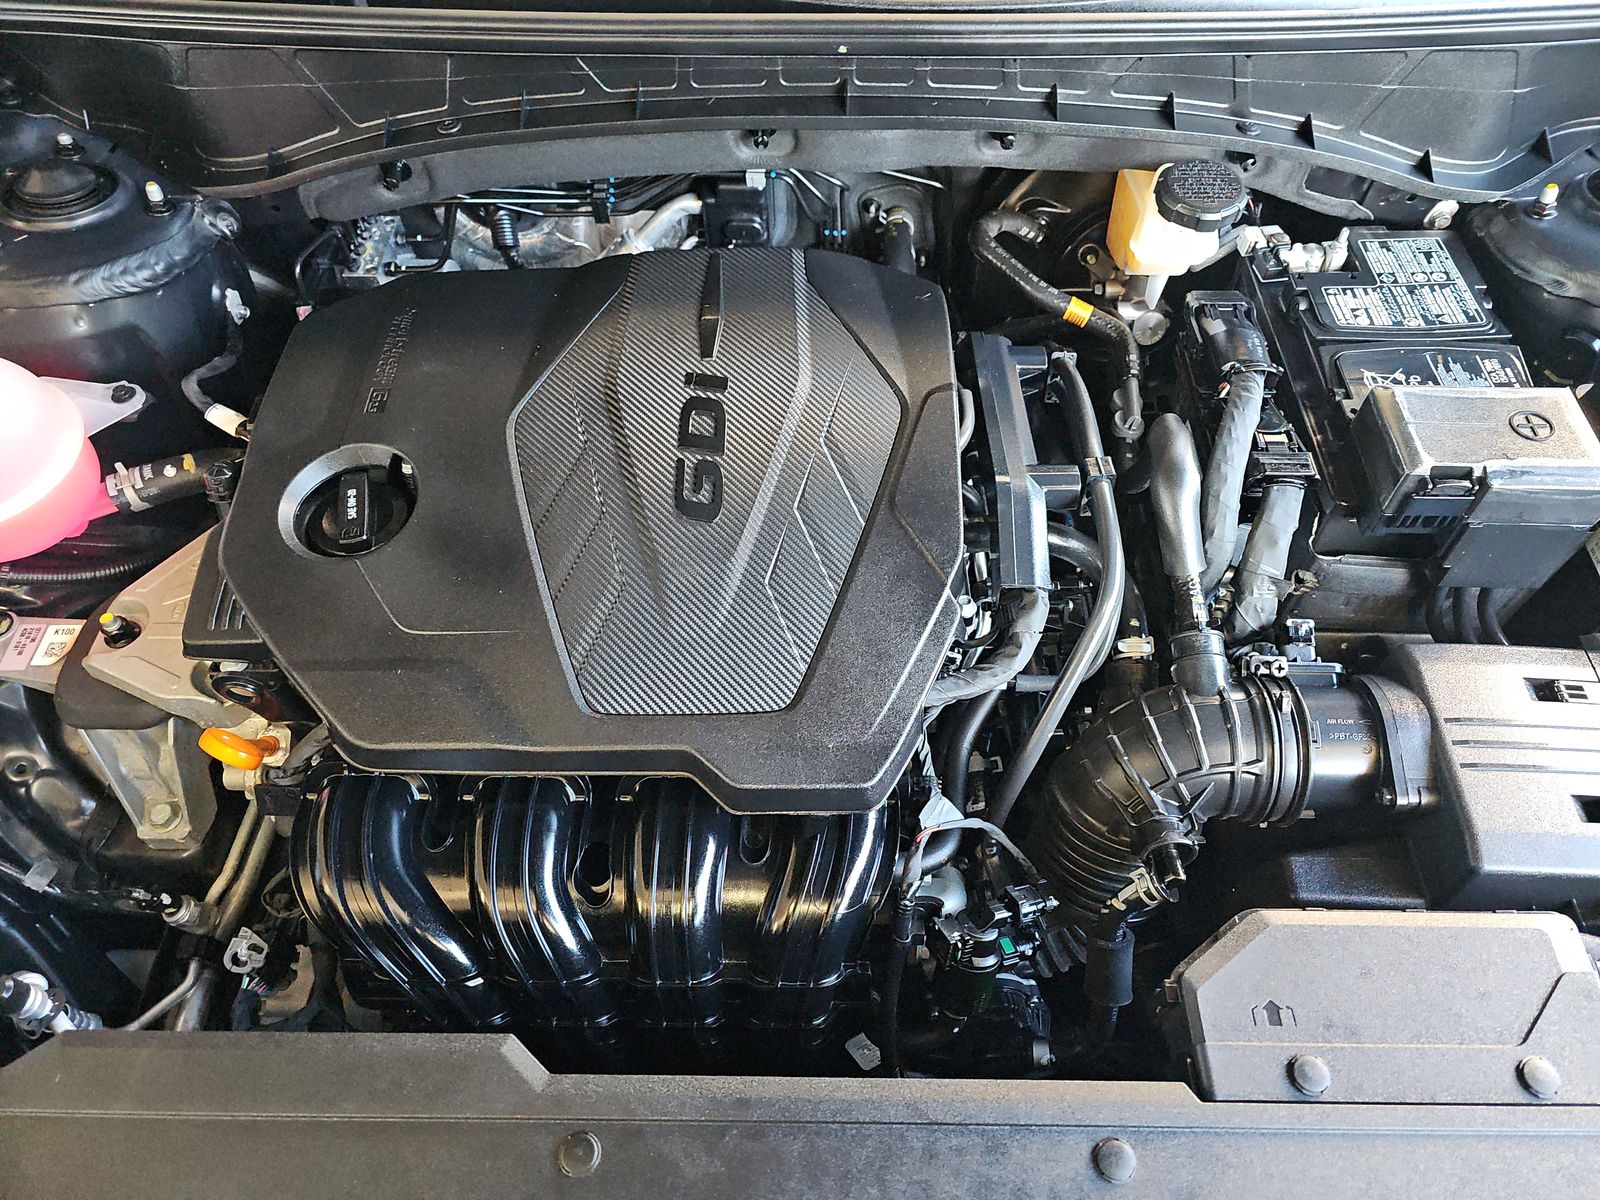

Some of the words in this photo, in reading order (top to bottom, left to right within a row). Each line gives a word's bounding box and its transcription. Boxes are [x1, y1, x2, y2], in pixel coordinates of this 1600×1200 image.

[142, 463, 154, 481] TANK
[347, 488, 357, 508] 0W-20
[347, 507, 357, 520] SAE
[53, 627, 76, 636] K100
